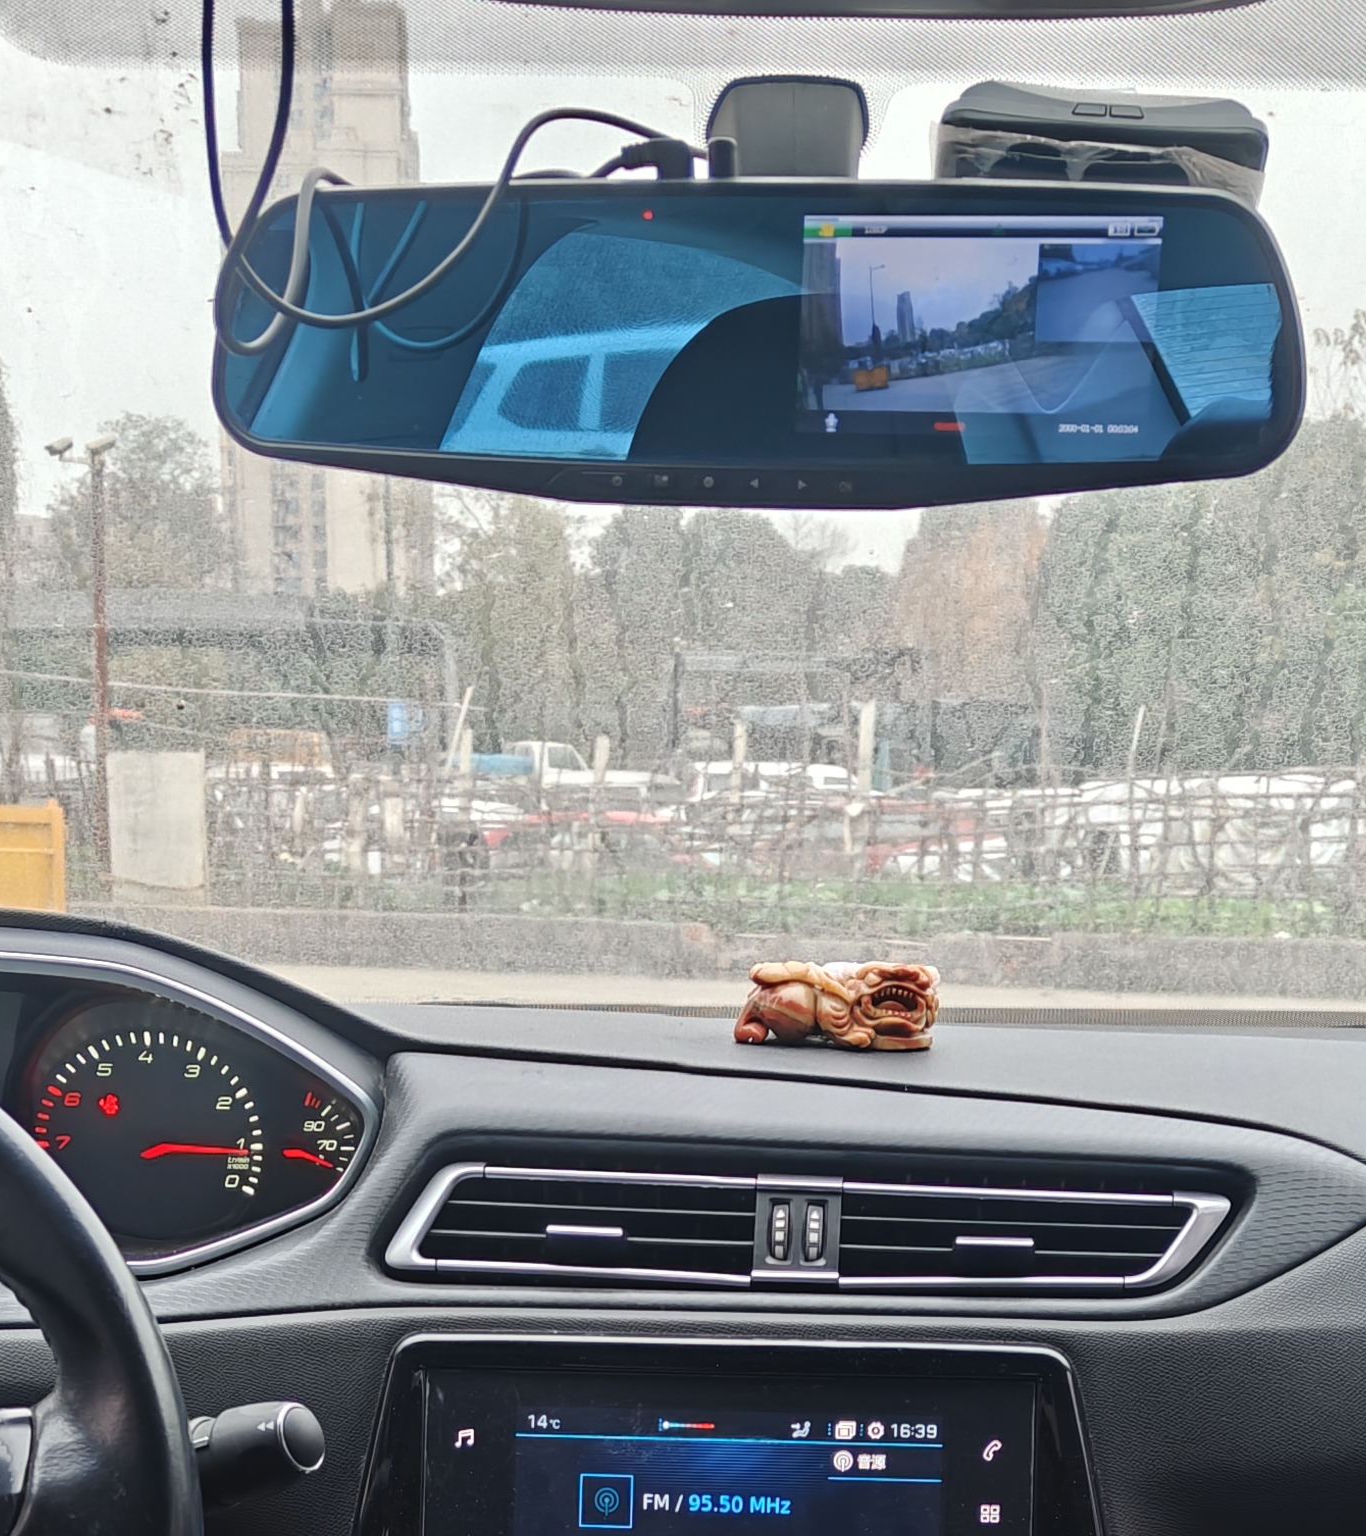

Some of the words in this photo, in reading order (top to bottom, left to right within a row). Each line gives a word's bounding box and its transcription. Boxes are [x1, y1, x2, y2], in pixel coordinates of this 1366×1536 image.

[138, 1050, 153, 1064] 4
[96, 1063, 113, 1076] 5
[184, 1064, 201, 1078] 3
[63, 1092, 81, 1107] 6
[216, 1096, 233, 1110] 2
[303, 1120, 325, 1132] 90
[55, 1135, 71, 1149] 7
[317, 1140, 338, 1151] 70
[224, 1174, 240, 1188] 0
[890, 1423, 938, 1439] 16:39
[642, 1493, 670, 1511] FM
[688, 1493, 744, 1514] 95.50
[749, 1495, 791, 1515] MHz
